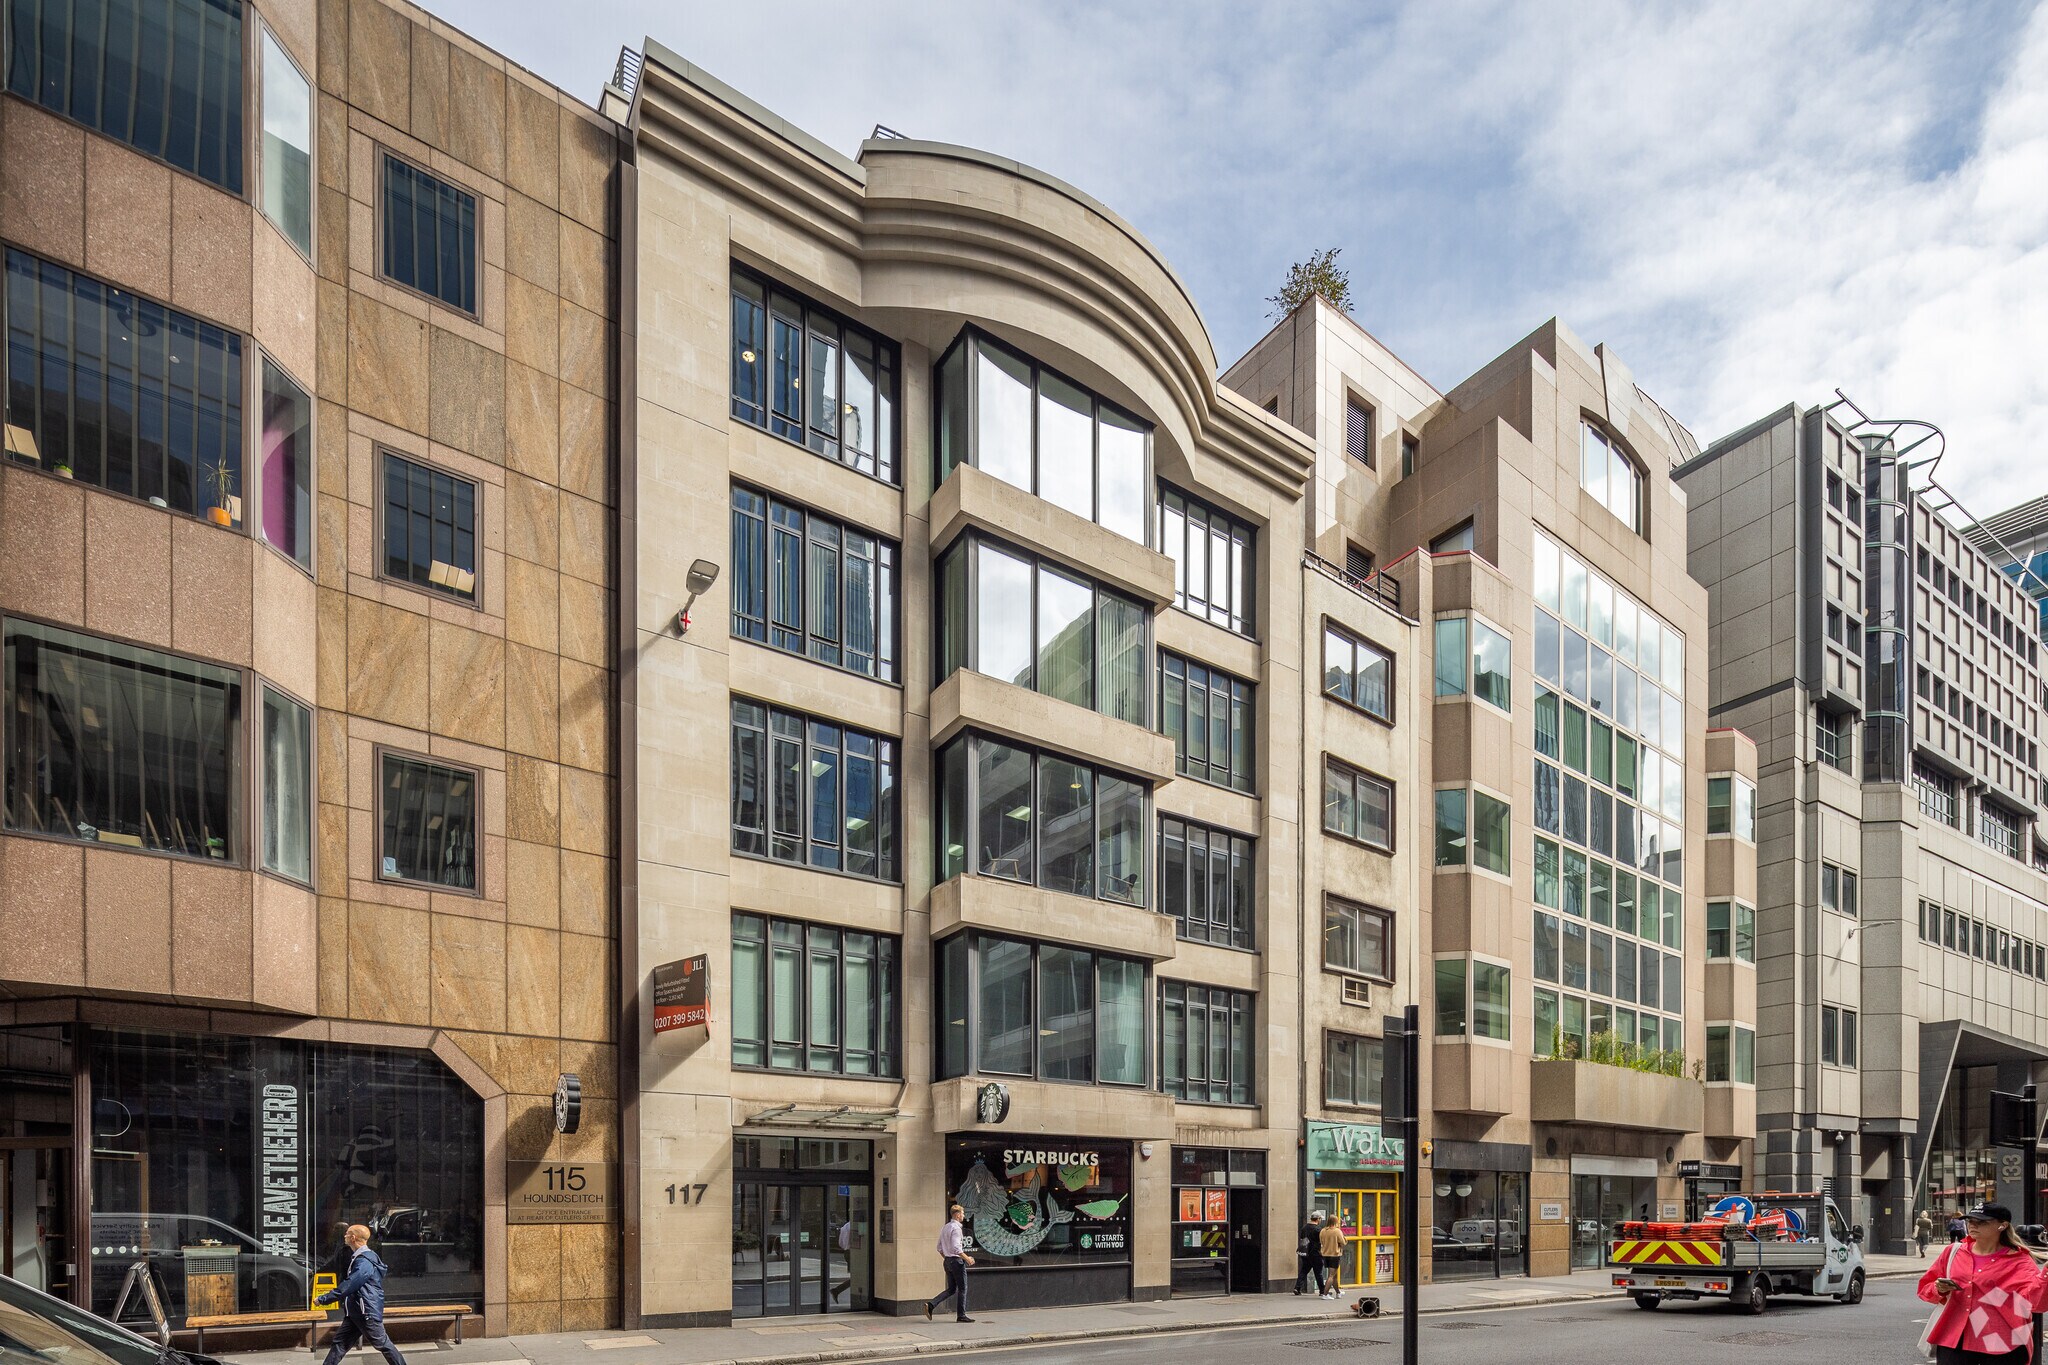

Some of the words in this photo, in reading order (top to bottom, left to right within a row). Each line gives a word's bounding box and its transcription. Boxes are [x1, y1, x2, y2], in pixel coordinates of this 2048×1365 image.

[692, 960, 704, 972] JLL
[654, 1016, 671, 1029] 0207
[672, 1012, 686, 1025] 399
[687, 1008, 705, 1022] 5842
[1003, 1149, 1099, 1166] STARBUCKS
[263, 1084, 298, 1257] #LEAVETHEHERD
[542, 1166, 586, 1191] 115
[2002, 1154, 2022, 1184] 133
[523, 1194, 604, 1203] HOUNDSDITCH
[665, 1183, 709, 1205] 117
[1094, 1234, 1101, 1242] IT
[1101, 1234, 1124, 1242] STARTS
[1094, 1241, 1111, 1249] WITH
[1111, 1241, 1124, 1249] YOU
